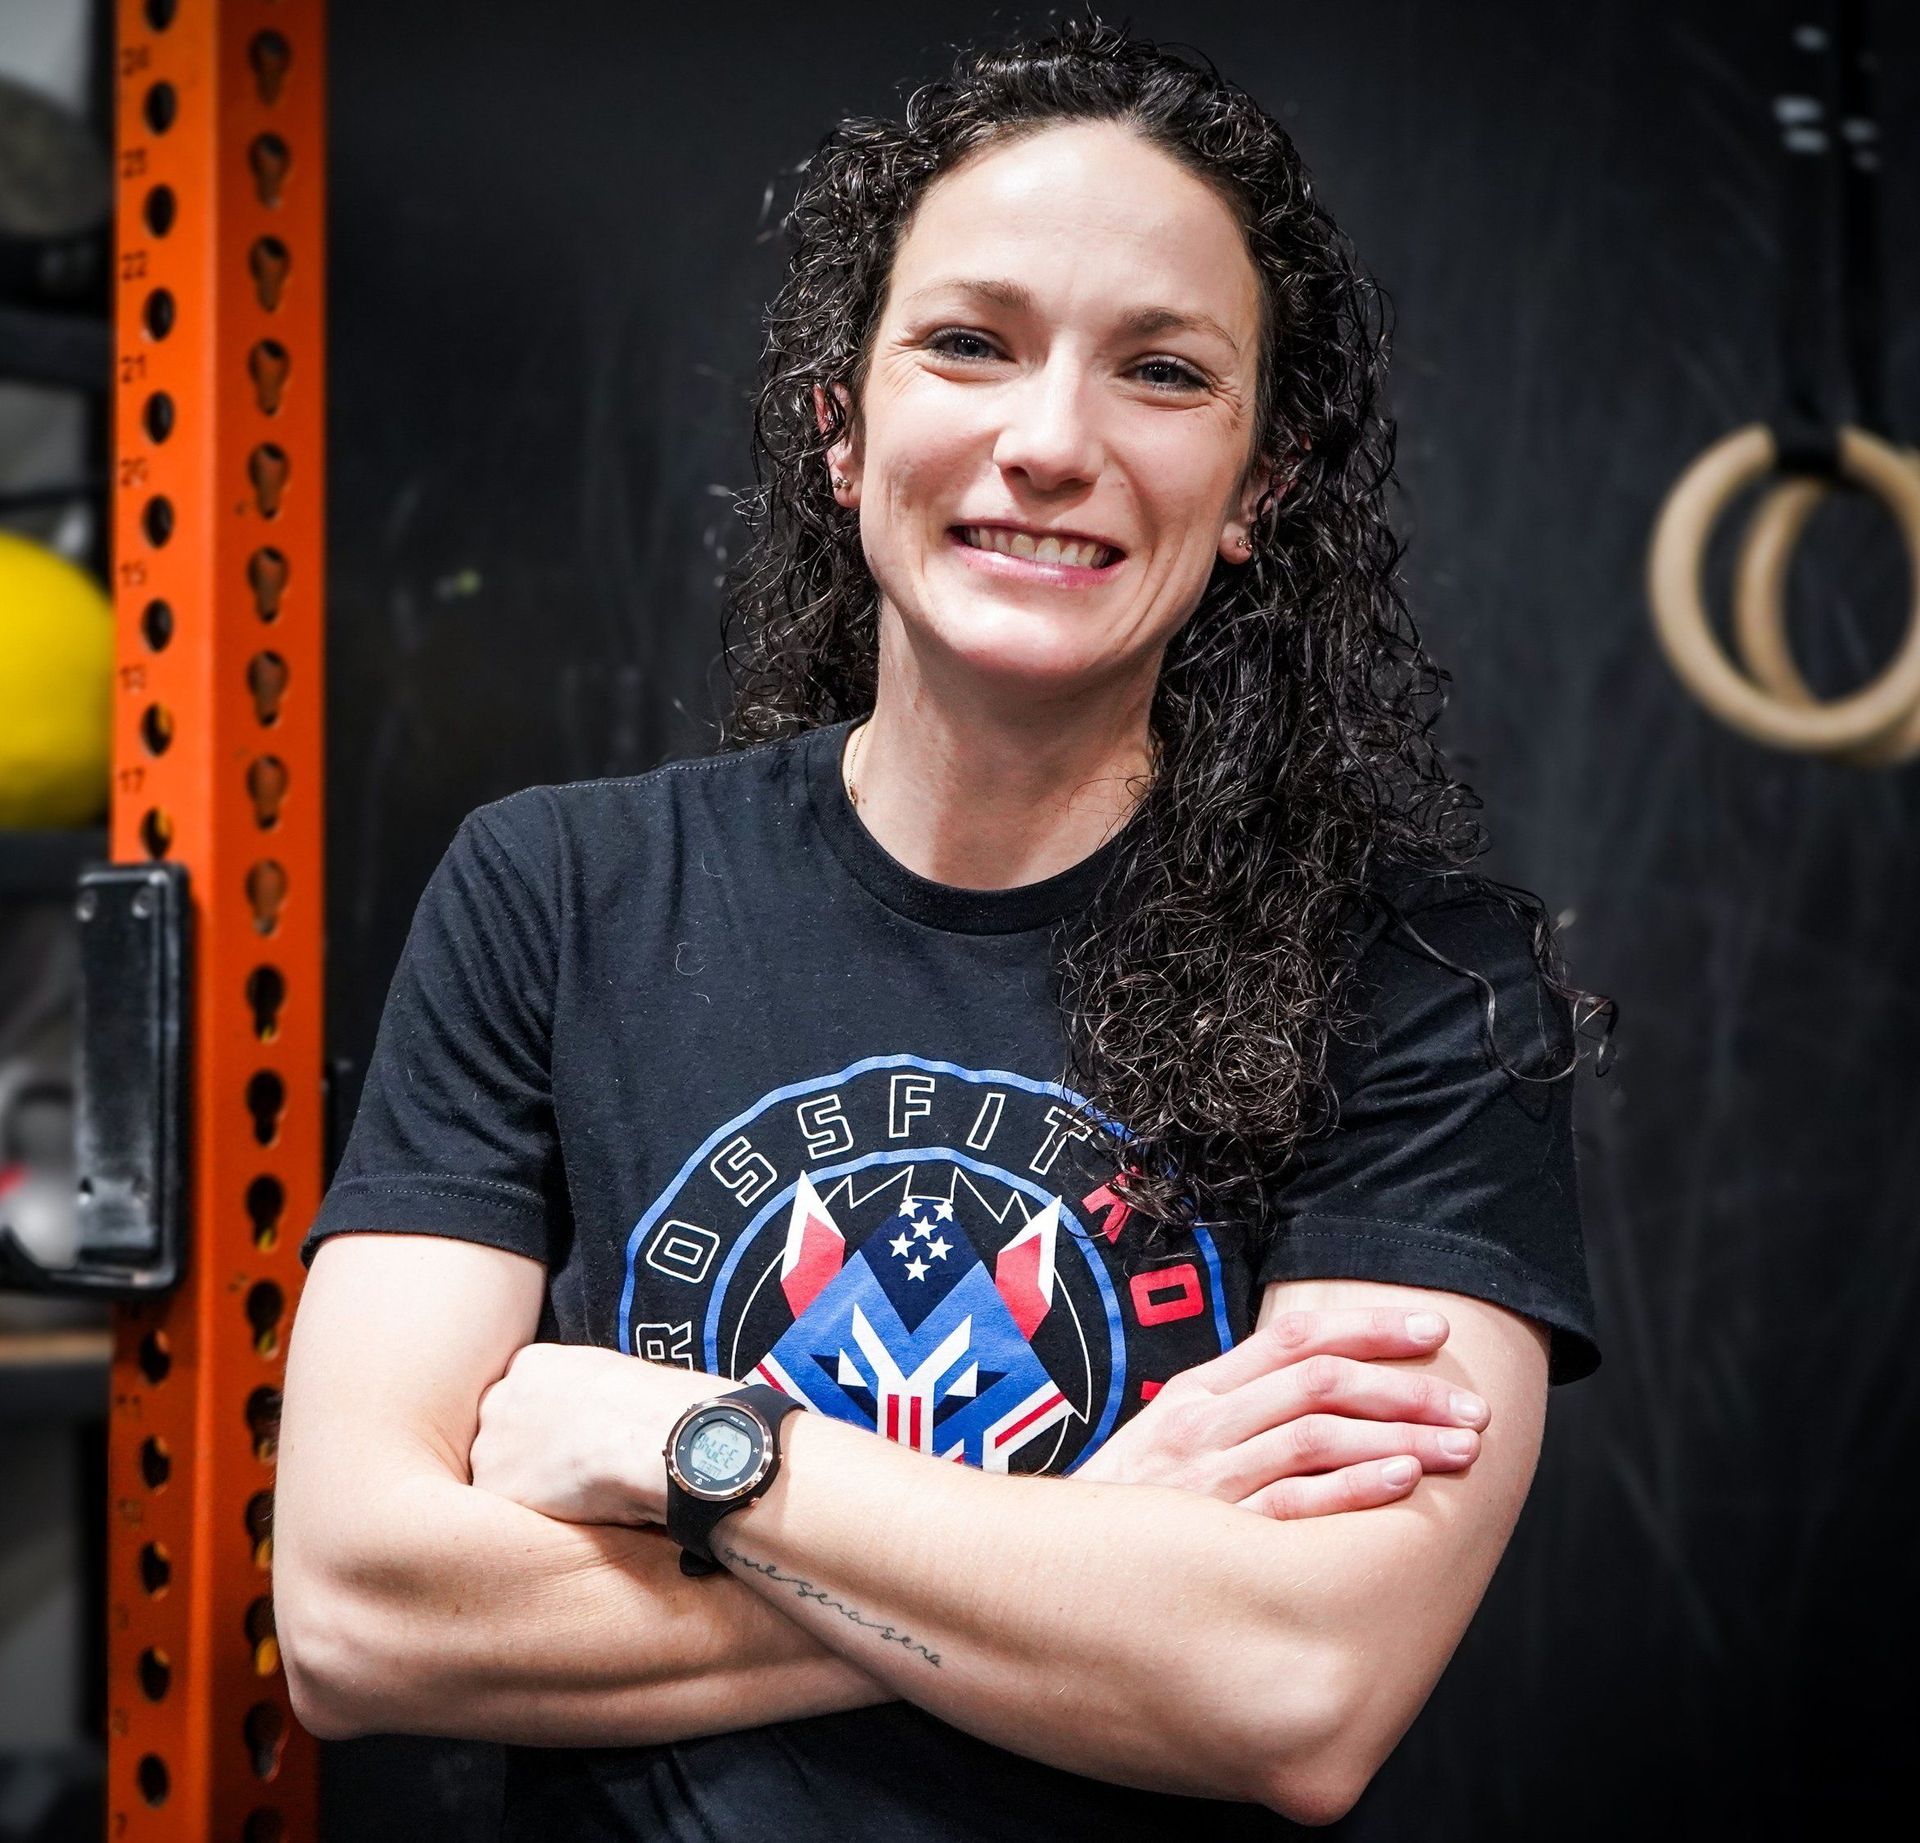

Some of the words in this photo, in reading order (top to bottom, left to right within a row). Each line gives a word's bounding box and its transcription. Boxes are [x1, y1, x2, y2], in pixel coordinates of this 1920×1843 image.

[121, 251, 146, 281] 22
[121, 354, 145, 385] 21
[117, 765, 145, 795] 17
